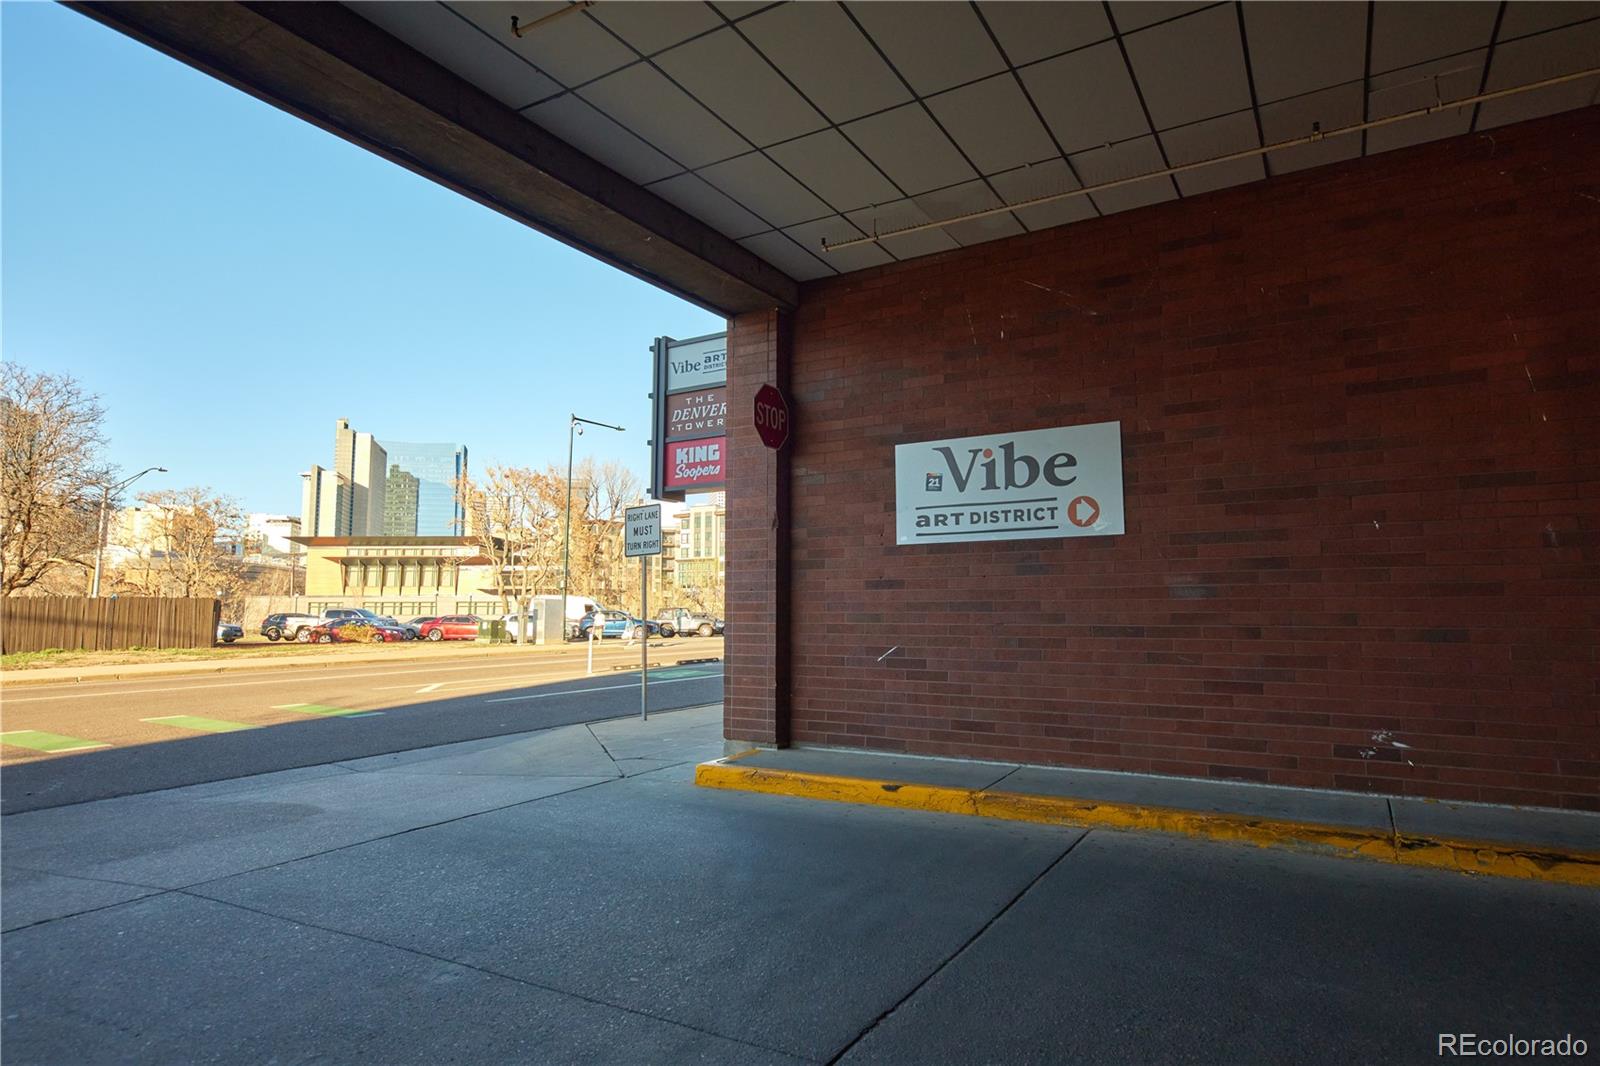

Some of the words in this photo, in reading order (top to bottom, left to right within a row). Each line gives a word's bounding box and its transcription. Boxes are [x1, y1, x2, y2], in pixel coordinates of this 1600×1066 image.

[671, 360, 701, 375] Vibe
[685, 394, 714, 405] THE
[671, 402, 727, 423] DENVER
[756, 401, 786, 431] STOP
[676, 418, 724, 431] TOWER
[675, 444, 720, 465] KING
[674, 463, 721, 481] Soopers
[932, 441, 1077, 493] Vibe
[928, 478, 940, 487] 21
[627, 512, 644, 522] RIGHT
[644, 510, 659, 520] LANE
[970, 506, 1058, 525] DISTRICT
[633, 525, 653, 537] MUST
[627, 542, 642, 551] TURN
[642, 539, 659, 550] RIGHT
